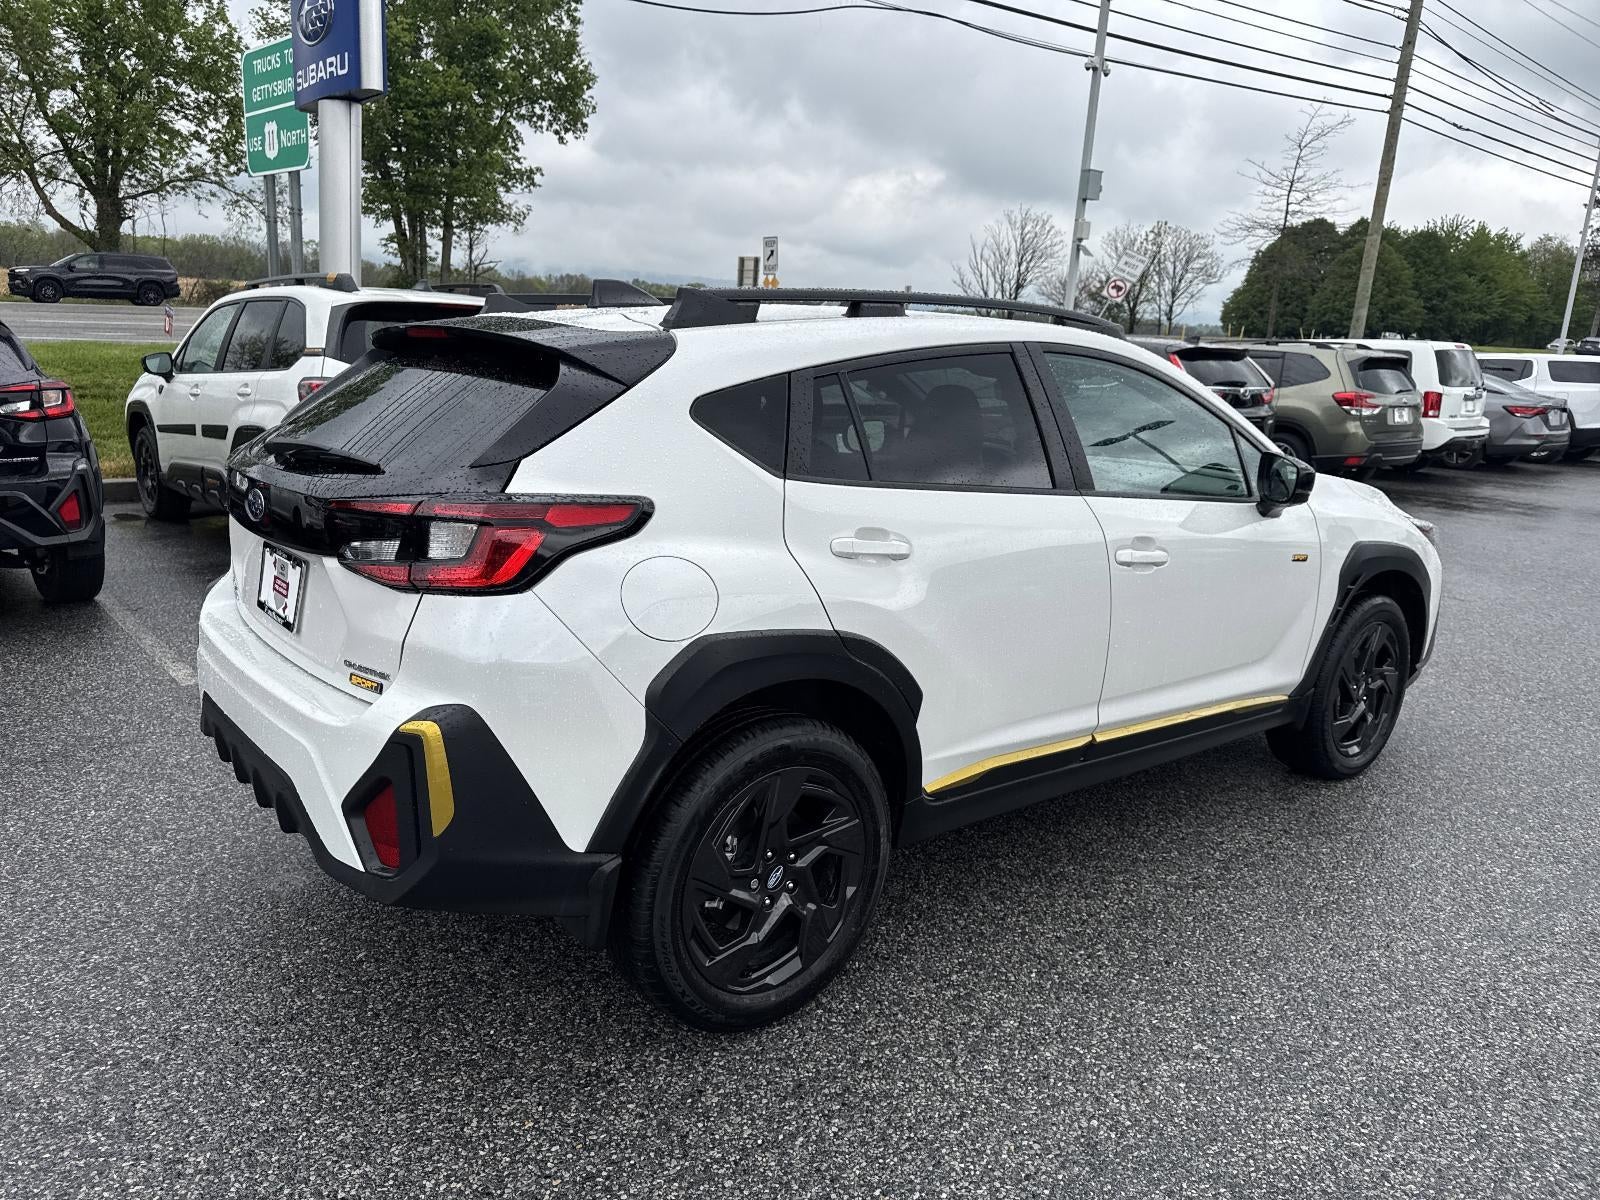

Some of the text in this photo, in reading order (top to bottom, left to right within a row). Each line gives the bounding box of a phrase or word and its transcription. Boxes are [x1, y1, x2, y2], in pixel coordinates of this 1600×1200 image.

[253, 47, 294, 75] TRUCKS TO
[296, 51, 349, 92] SUBARU
[252, 76, 295, 103] GETTYSBUR
[248, 128, 307, 152] USE 11 NORTH
[351, 674, 379, 691] SPORT
